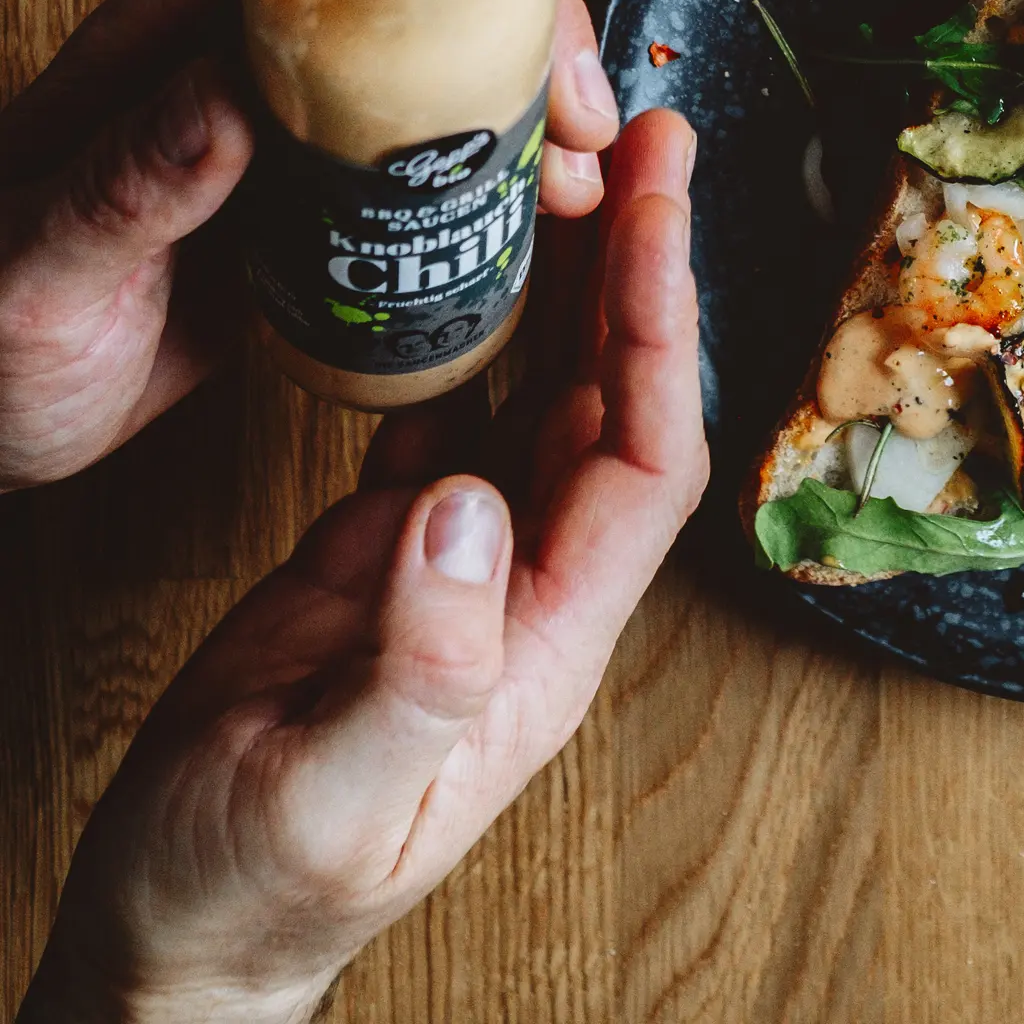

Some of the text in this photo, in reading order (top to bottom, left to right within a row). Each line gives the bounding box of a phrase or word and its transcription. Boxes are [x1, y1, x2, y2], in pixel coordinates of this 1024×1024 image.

[328, 193, 524, 294] Chili
[329, 177, 526, 257] Knoblauch
[387, 193, 488, 232] SAUCEN
